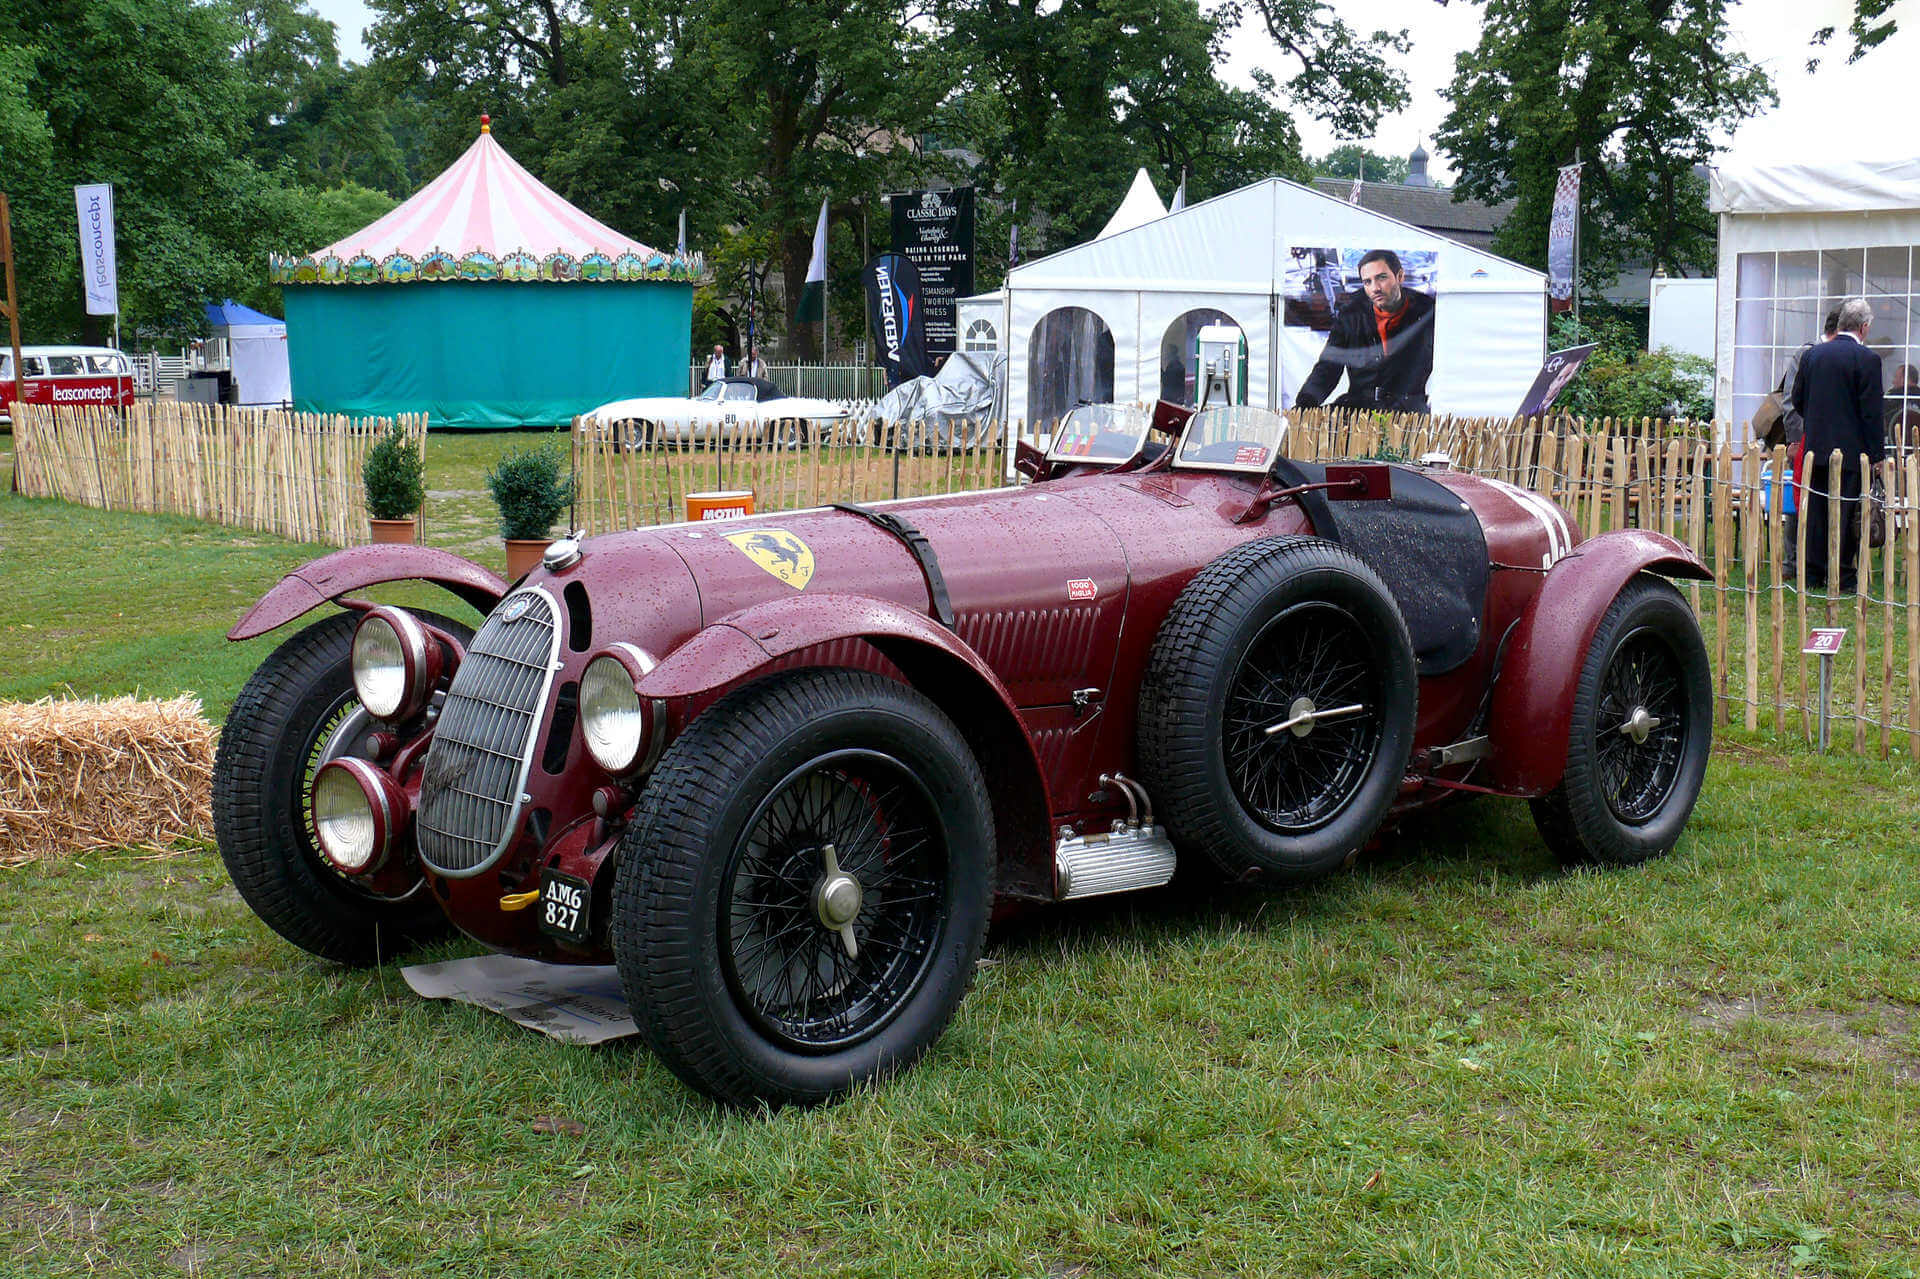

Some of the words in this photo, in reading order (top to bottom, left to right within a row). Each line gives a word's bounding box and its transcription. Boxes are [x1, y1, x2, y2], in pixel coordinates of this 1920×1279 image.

[907, 208, 937, 219] CLASSIC
[938, 206, 958, 217] DAYS
[929, 245, 960, 253] LEGENDS
[948, 253, 967, 261] PARK
[922, 287, 956, 296] TSMANSHIP
[52, 384, 112, 403] leasconcept
[702, 507, 747, 520] MOTUL
[1071, 589, 1092, 597] MIGLIA
[1814, 635, 1833, 646] 20
[545, 880, 582, 909] AM6
[545, 901, 579, 932] 827
